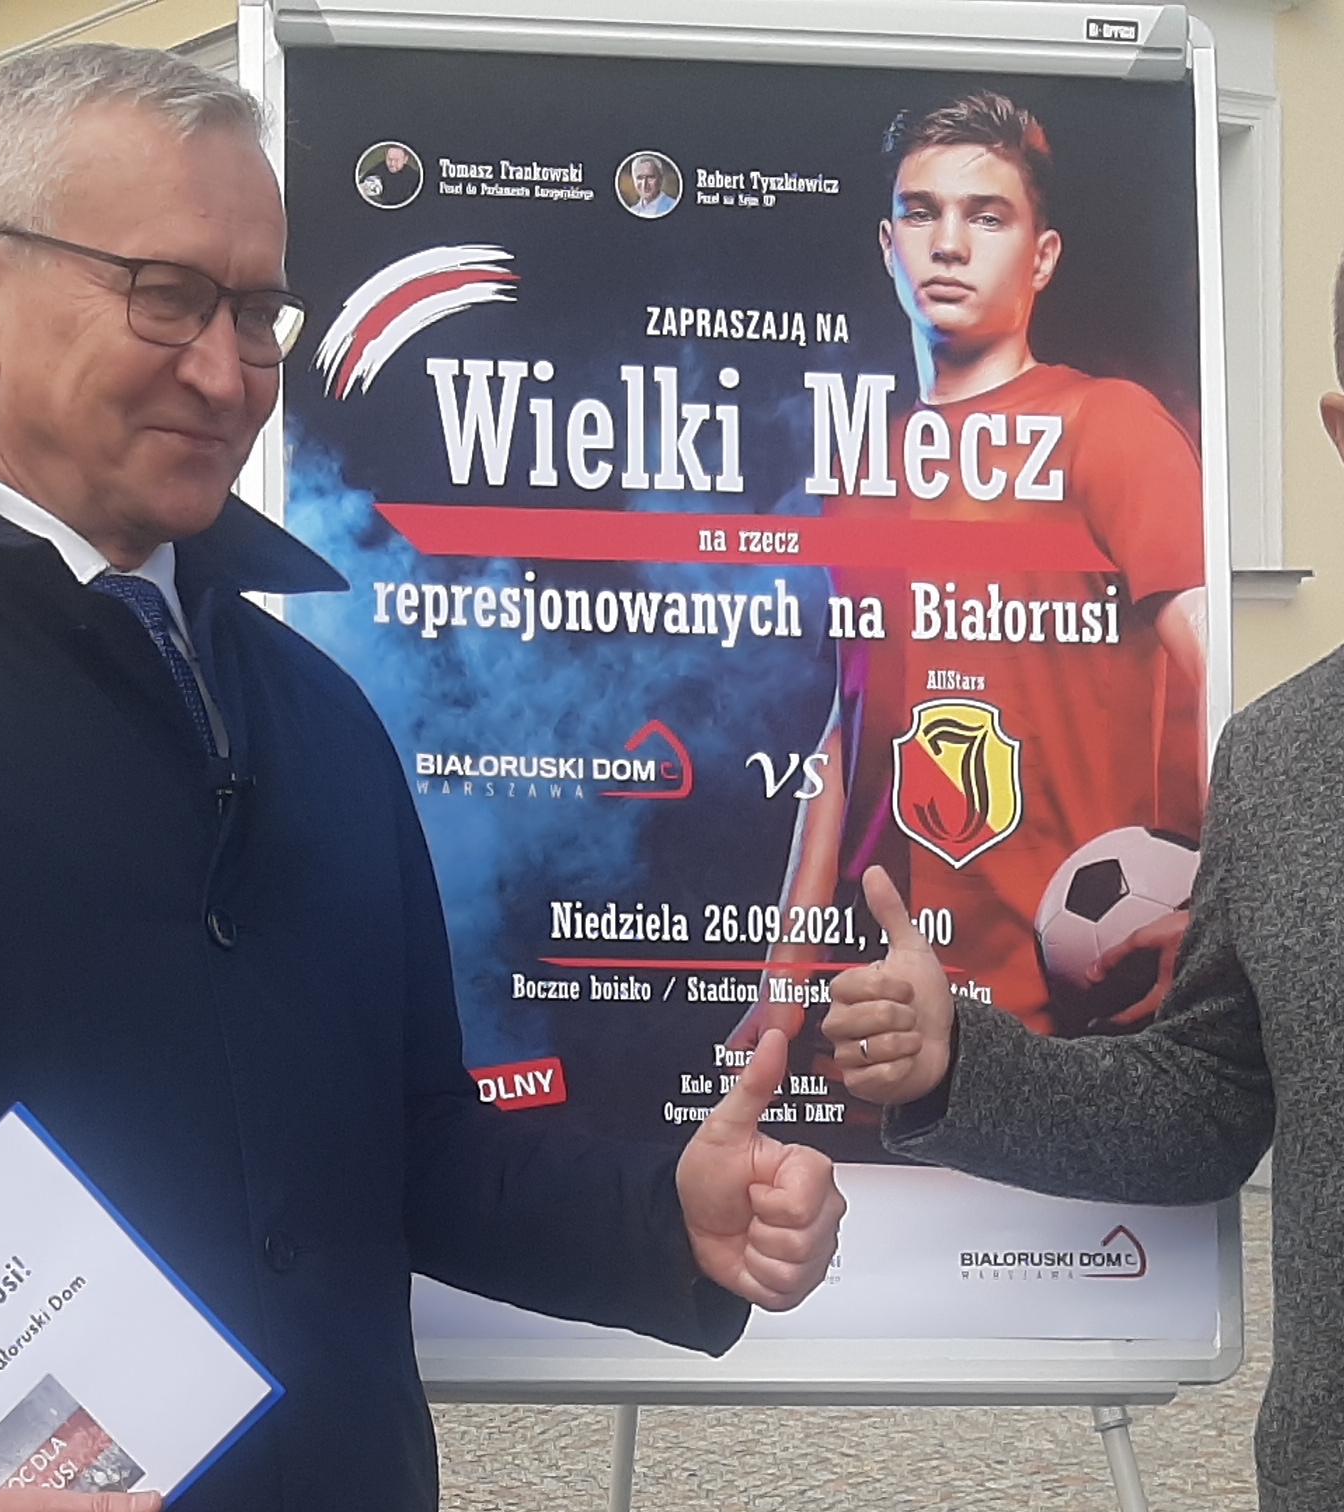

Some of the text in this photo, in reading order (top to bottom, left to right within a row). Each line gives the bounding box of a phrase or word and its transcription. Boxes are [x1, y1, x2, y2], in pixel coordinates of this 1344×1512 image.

[439, 158, 493, 179] Tomasz
[696, 168, 840, 194] Robert Tyszkiewicz
[646, 306, 849, 346] ZAPRASZAJĄ NA
[426, 357, 1065, 503] Wielki Mecz
[698, 529, 800, 555] na rzecz
[372, 571, 1121, 648] represjonowanych na Białorusi
[927, 669, 985, 691] AllStars
[416, 753, 656, 782] BIAŁORUSKI DOM
[416, 780, 584, 799] WARSZAWA
[550, 901, 689, 942] Niedziela
[704, 904, 866, 951] 26.09.2021,
[512, 974, 832, 1005] Boczne boisko / Stadion Miejsk
[714, 1044, 755, 1067] Pona
[477, 1068, 554, 1103] OLNY
[681, 1074, 713, 1094] Kule
[790, 1076, 828, 1095] BALL
[664, 1101, 845, 1125] Ogrom arski DART
[960, 1252, 1122, 1267] BIAŁORUSKI DOM
[47, 1274, 87, 1313] Dom
[30, 1437, 67, 1471] DLA
